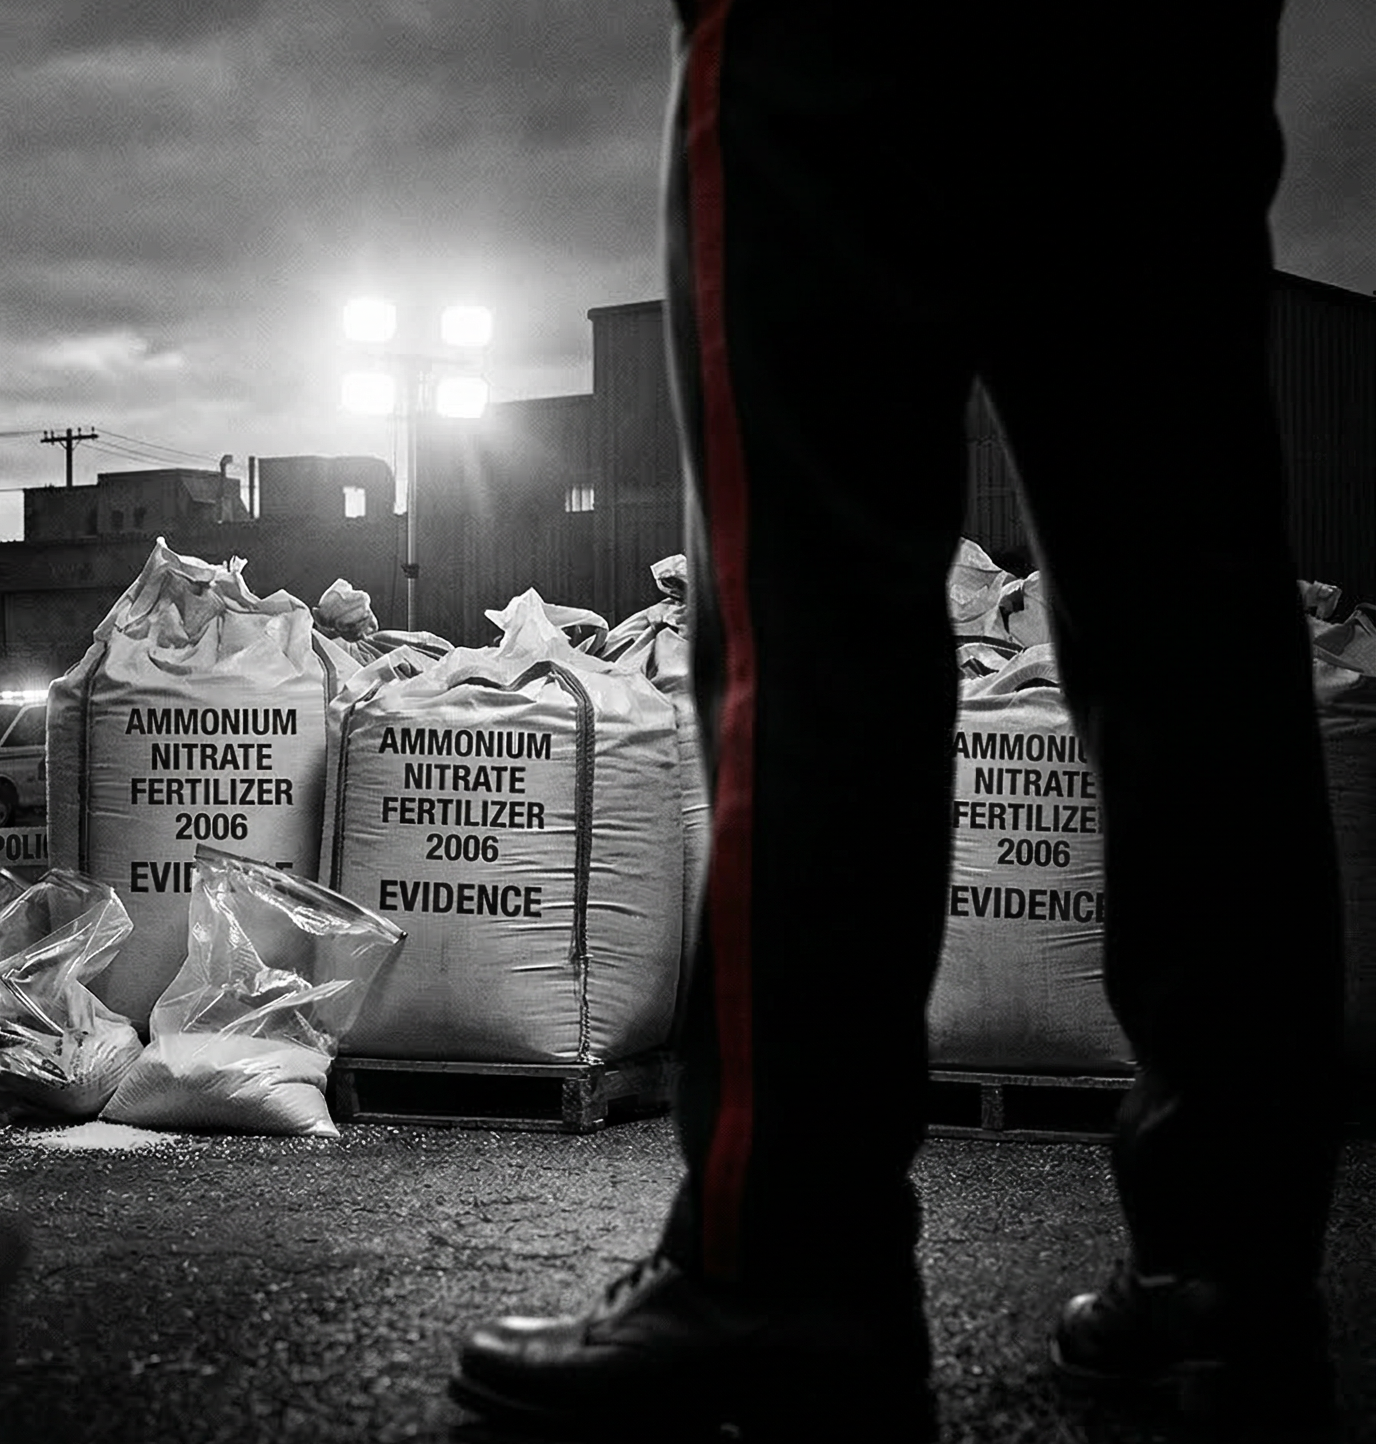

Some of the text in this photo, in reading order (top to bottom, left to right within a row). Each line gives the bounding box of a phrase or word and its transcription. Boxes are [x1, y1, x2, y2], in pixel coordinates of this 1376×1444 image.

[125, 708, 296, 735] AMMONIUM
[152, 743, 272, 770] NITRATE
[379, 727, 551, 760] AMMONIUM
[953, 731, 1088, 763] AMMONI
[131, 778, 293, 805] FERTILIZER
[404, 763, 525, 793] NITRATE
[975, 767, 1097, 798] NITRATE
[176, 813, 247, 840] 2006
[382, 797, 544, 829] FERTILIZER
[426, 834, 498, 862] 2006
[998, 838, 1070, 867] 2006
[380, 880, 541, 918] EVIDENCE
